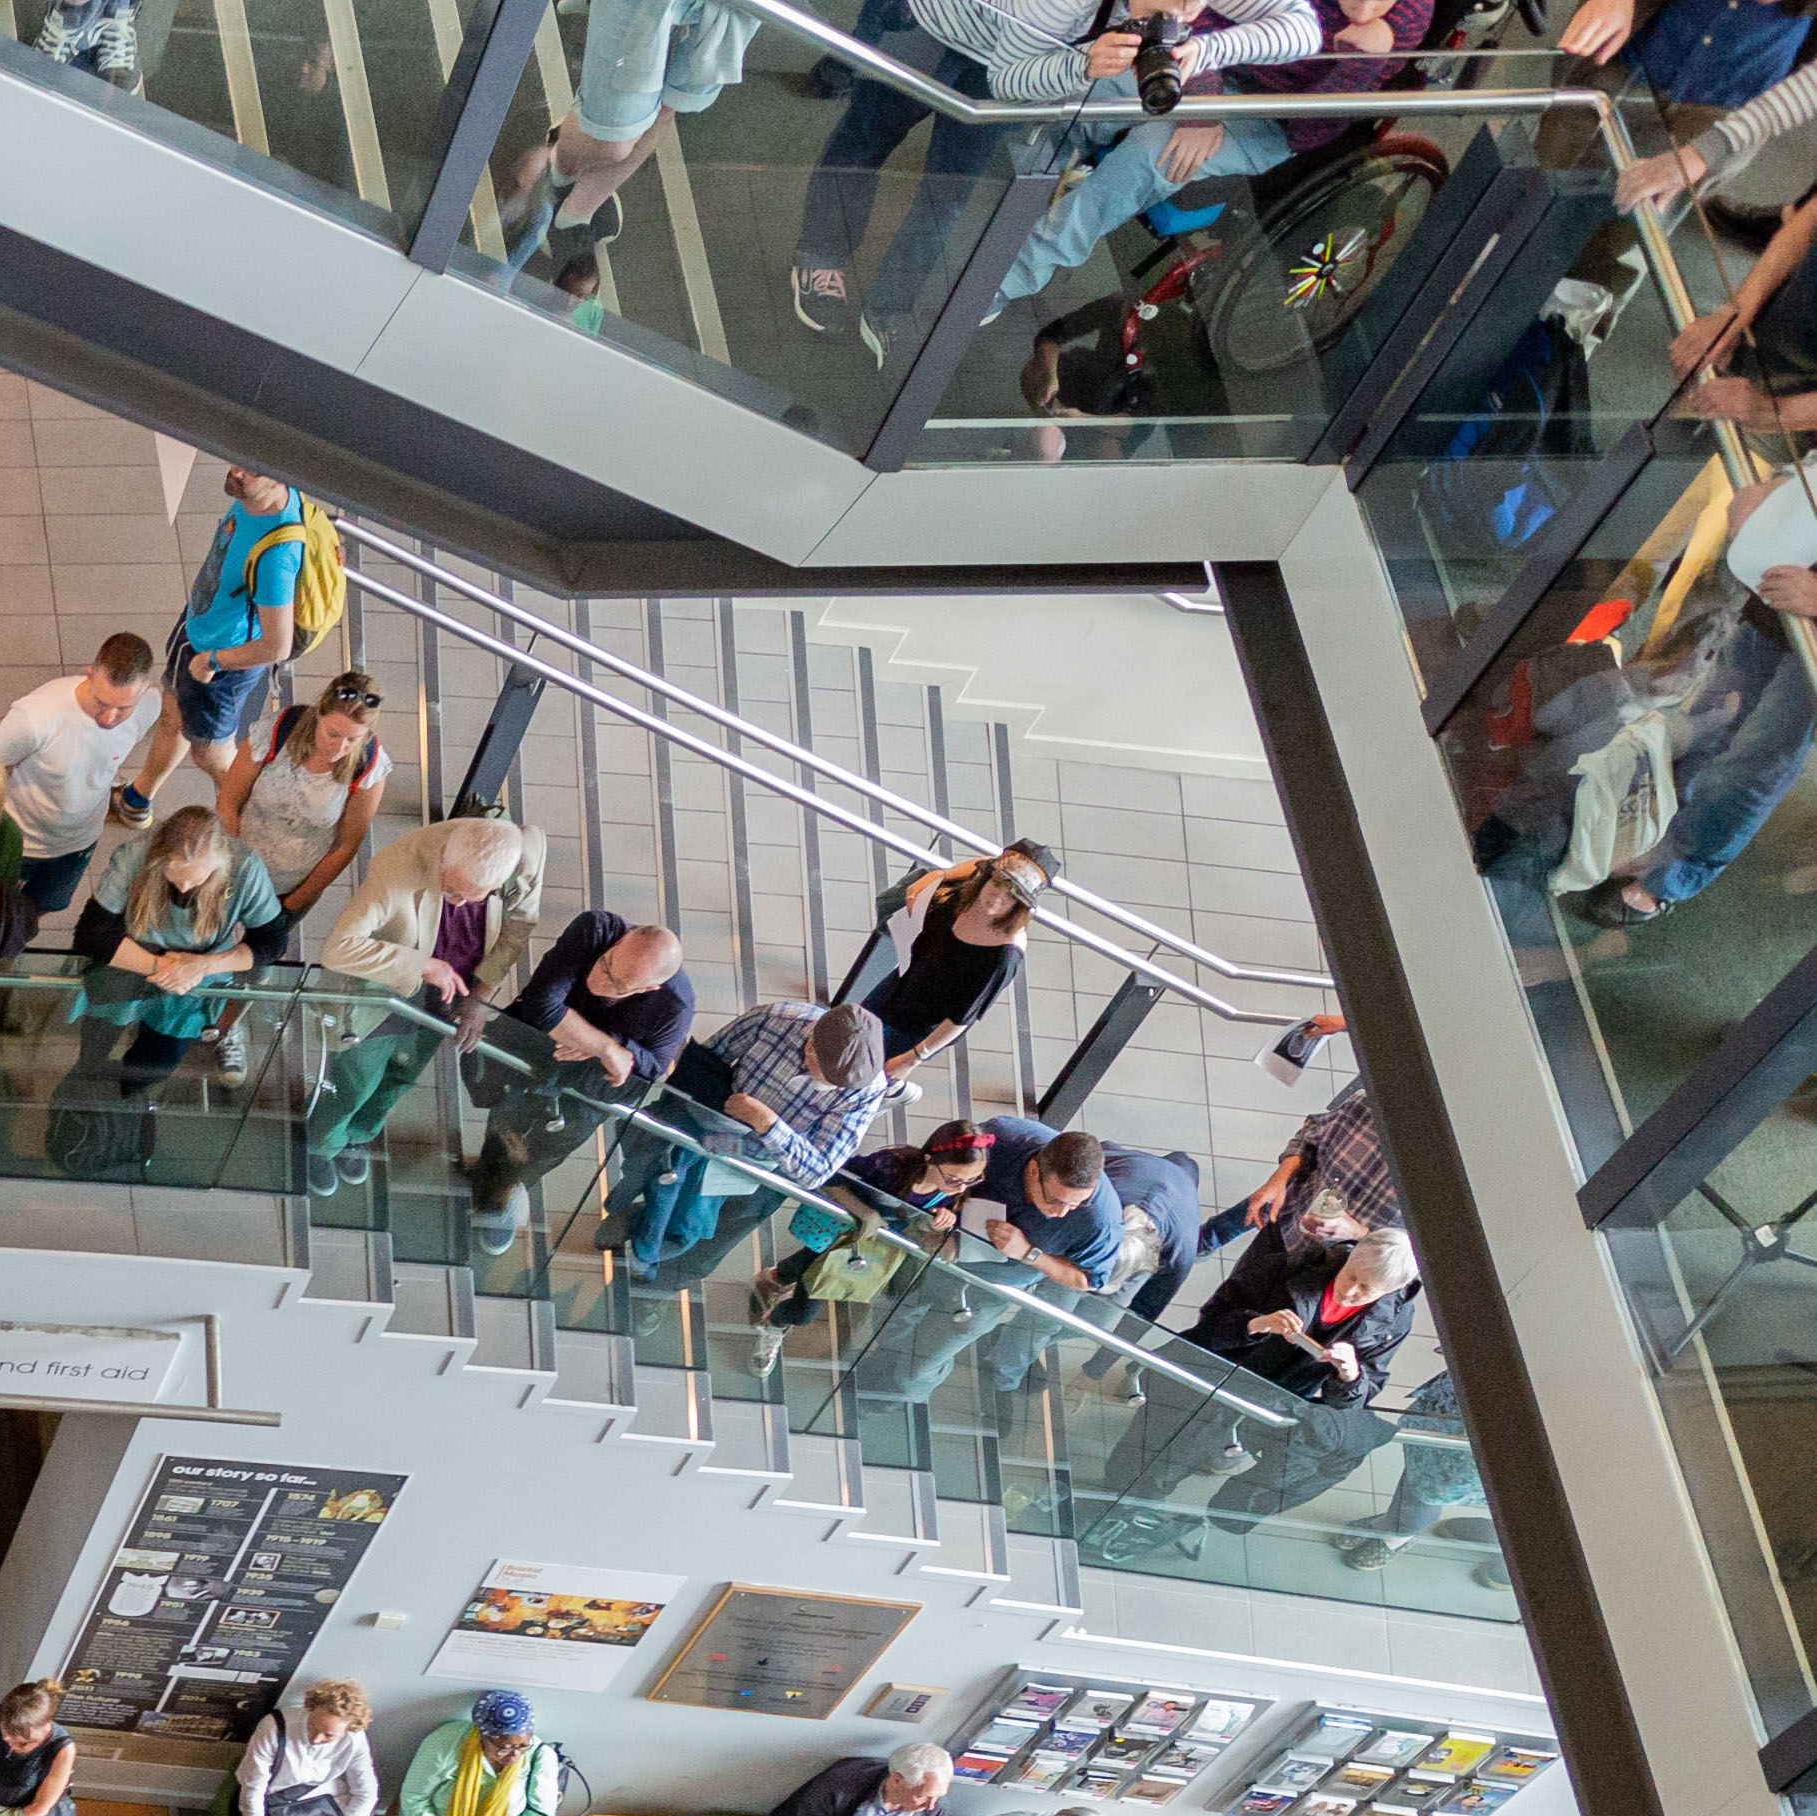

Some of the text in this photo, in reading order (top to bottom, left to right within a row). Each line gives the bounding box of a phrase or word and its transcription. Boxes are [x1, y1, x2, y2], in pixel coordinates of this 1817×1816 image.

[46, 1359, 93, 1378] first
[101, 1364, 149, 1381] aid
[172, 1465, 205, 1476] our
[207, 1467, 253, 1482] story
[255, 1472, 278, 1482] so
